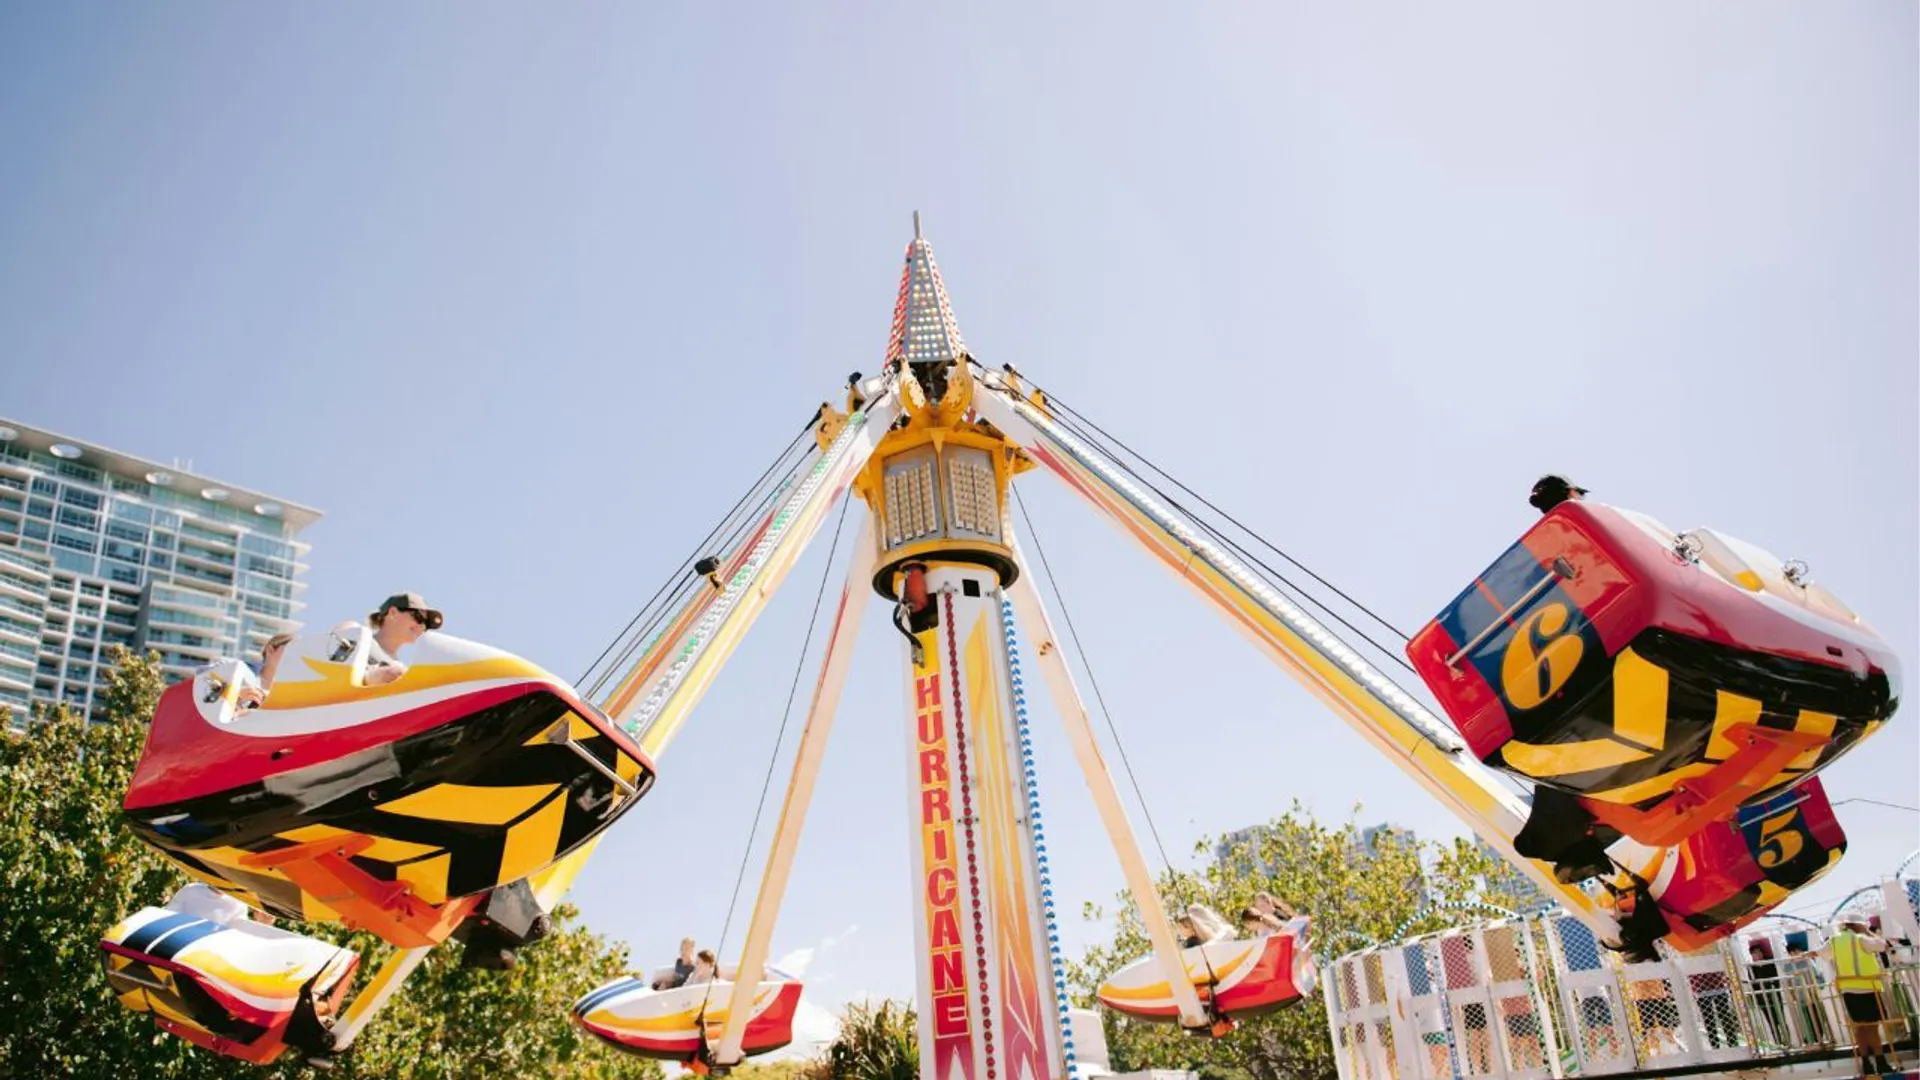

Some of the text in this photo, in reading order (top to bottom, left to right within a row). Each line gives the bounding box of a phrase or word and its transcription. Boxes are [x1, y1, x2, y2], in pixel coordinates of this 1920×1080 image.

[1502, 603, 1583, 709] 6
[915, 674, 968, 1037] HURRICANE
[1758, 807, 1803, 868] 5
